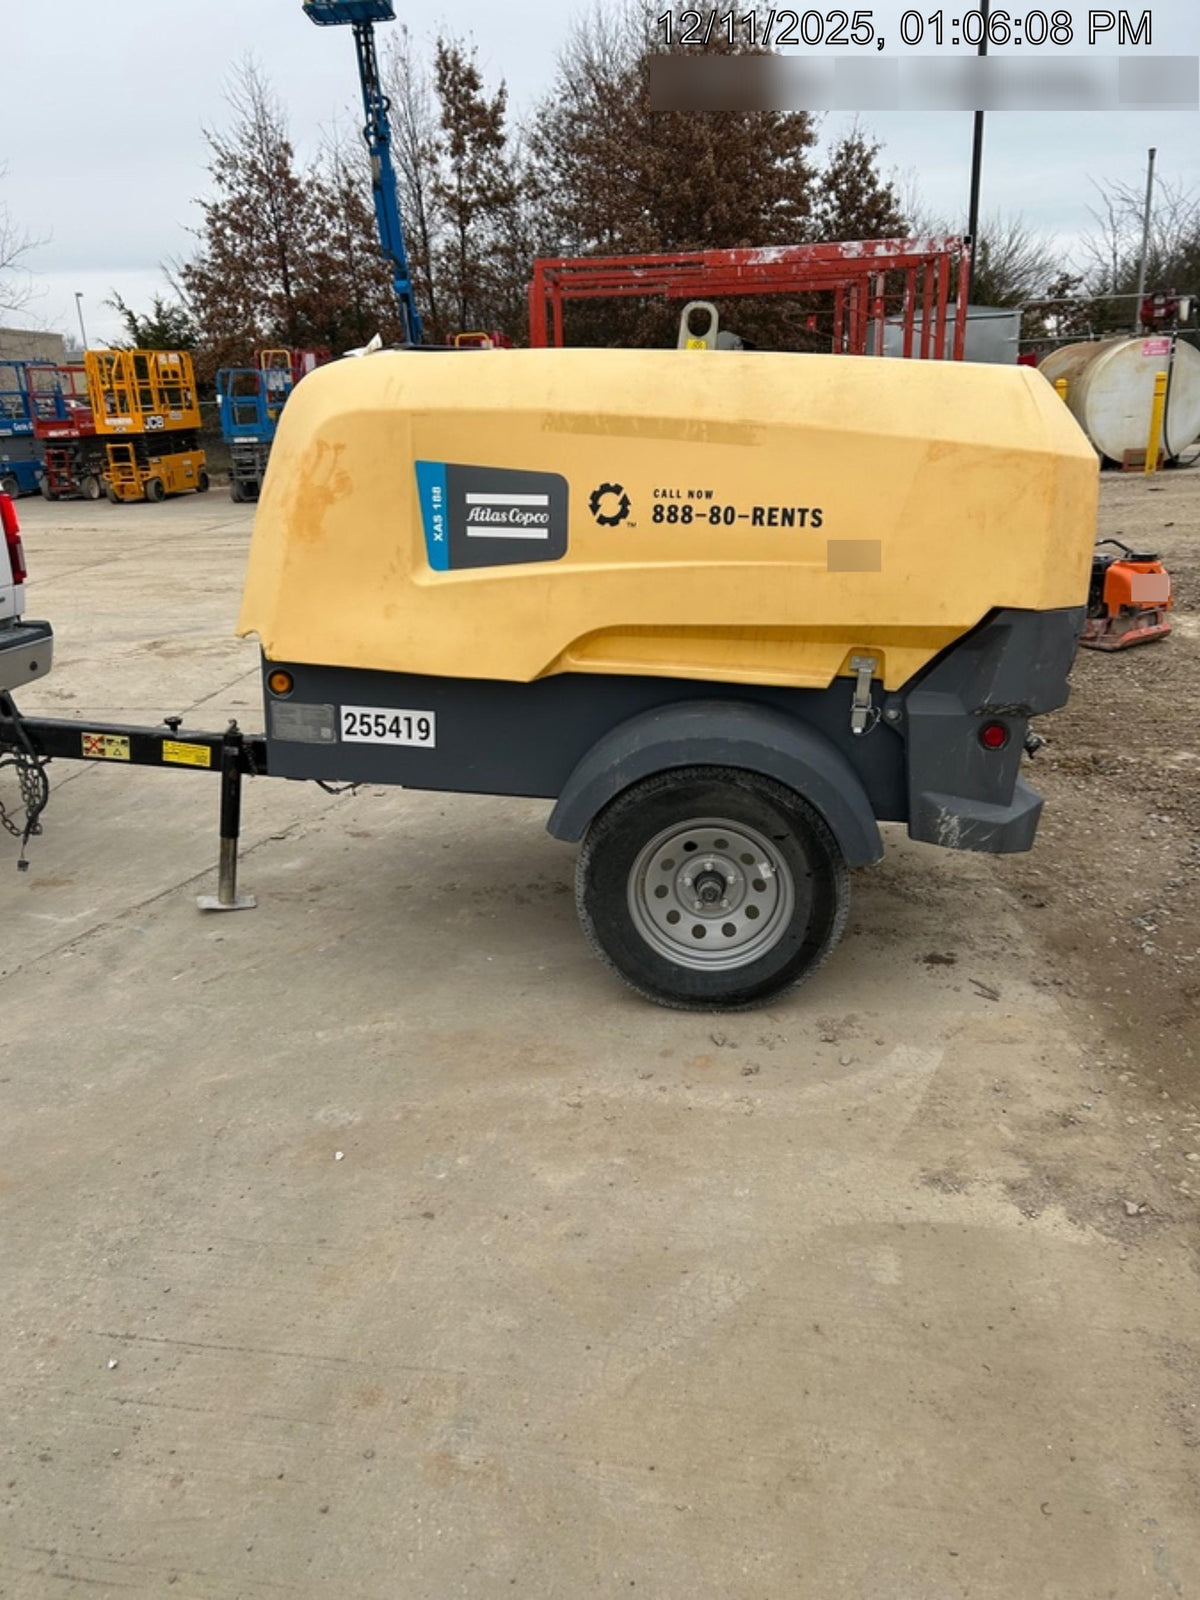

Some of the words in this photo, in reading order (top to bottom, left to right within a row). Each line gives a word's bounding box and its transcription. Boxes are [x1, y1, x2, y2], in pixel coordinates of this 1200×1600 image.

[653, 488, 682, 498] CALL
[687, 490, 714, 499] NOW
[432, 515, 443, 541] XAS
[466, 506, 508, 522] Atlas
[508, 507, 549, 525] Copco
[652, 503, 823, 528] 888-80-RENTS
[344, 712, 430, 741] 255419
